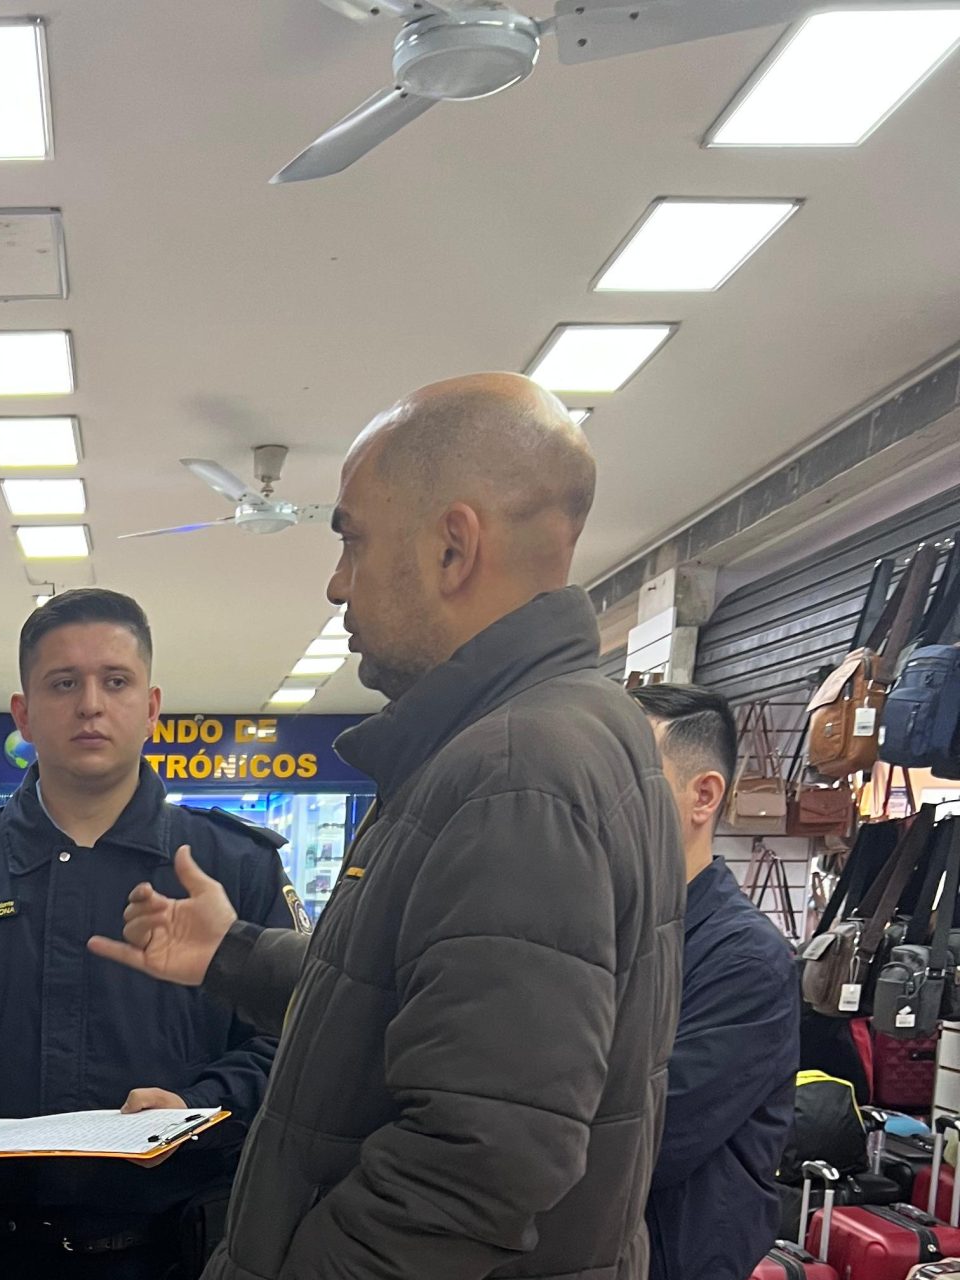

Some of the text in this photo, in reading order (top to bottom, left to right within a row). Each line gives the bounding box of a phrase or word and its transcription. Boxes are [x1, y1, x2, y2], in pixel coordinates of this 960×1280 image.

[152, 719, 278, 743] NDO DE
[144, 749, 317, 779] TRÓNICOS
